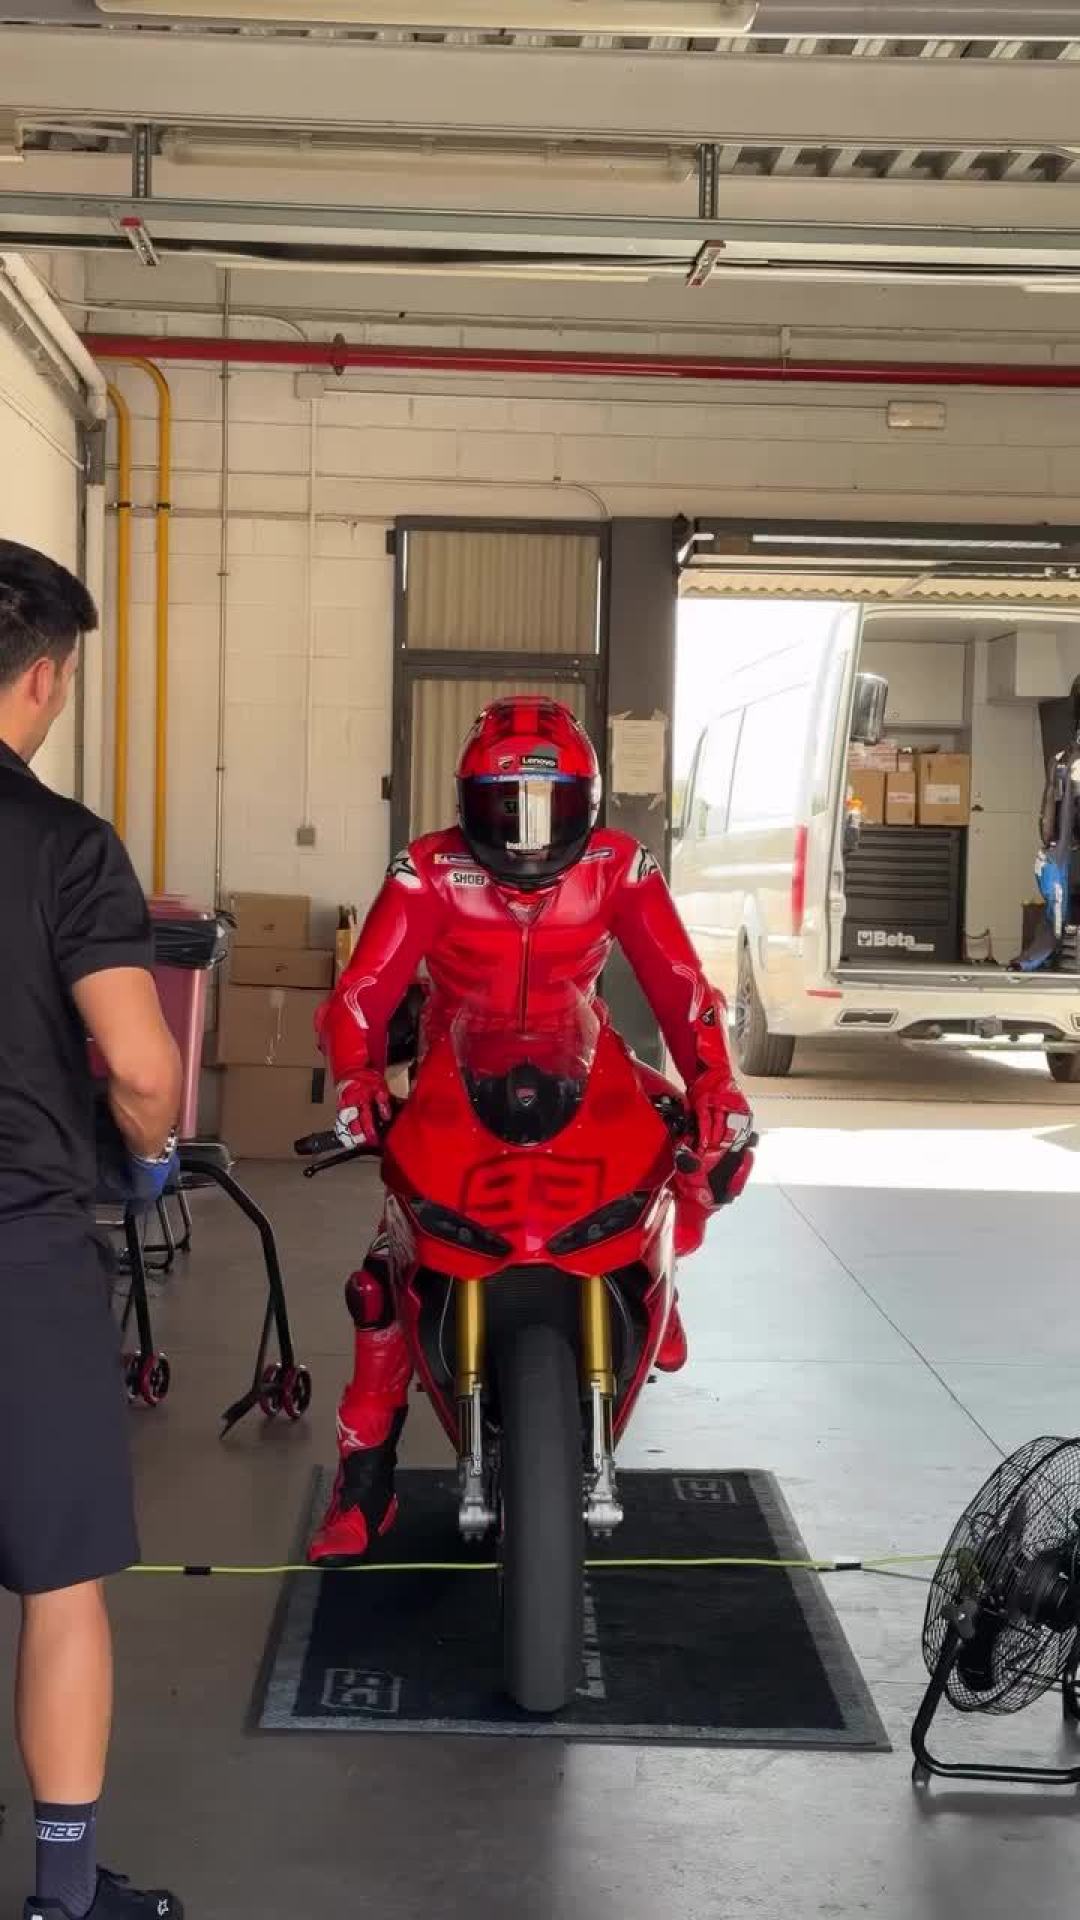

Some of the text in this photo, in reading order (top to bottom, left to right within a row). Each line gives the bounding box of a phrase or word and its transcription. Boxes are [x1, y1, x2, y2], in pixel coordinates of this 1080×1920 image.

[522, 756, 556, 767] Lenovo
[452, 872, 486, 886] SHOEI
[873, 930, 916, 947] Beta
